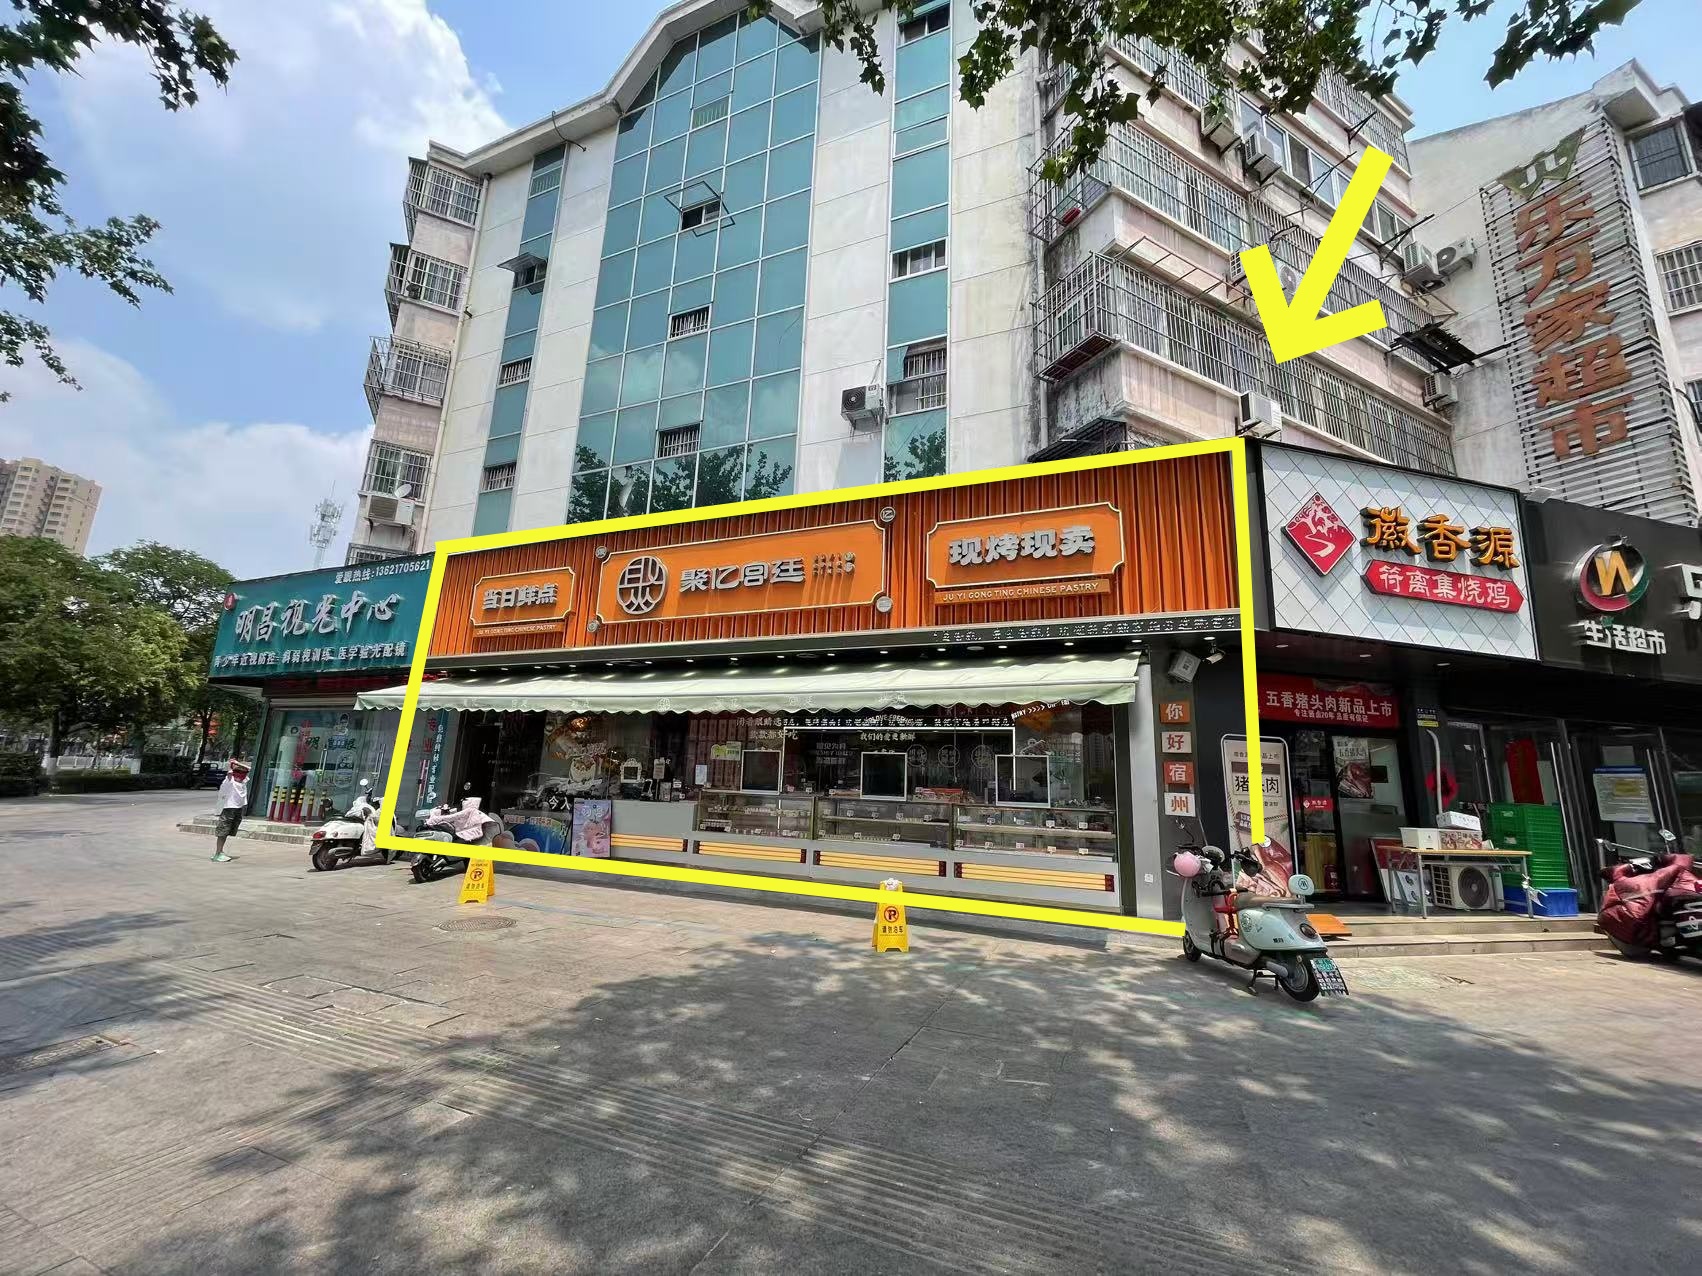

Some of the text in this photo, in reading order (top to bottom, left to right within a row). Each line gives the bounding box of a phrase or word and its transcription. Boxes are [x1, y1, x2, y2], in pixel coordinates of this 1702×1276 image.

[949, 525, 1095, 566] 现烤现卖
[1361, 506, 1520, 570] 徽香源
[680, 556, 805, 593] 聚亿宫廷
[943, 582, 1099, 601] JU YI GONG TING CHINESE PASTRY
[1379, 564, 1511, 609] 符离集烧鸡
[482, 583, 558, 610] 当日鲜点
[1584, 616, 1667, 655] 生活超市
[1266, 691, 1392, 717] 五香猪头肉新品上市
[1235, 776, 1279, 793] 猪肉
